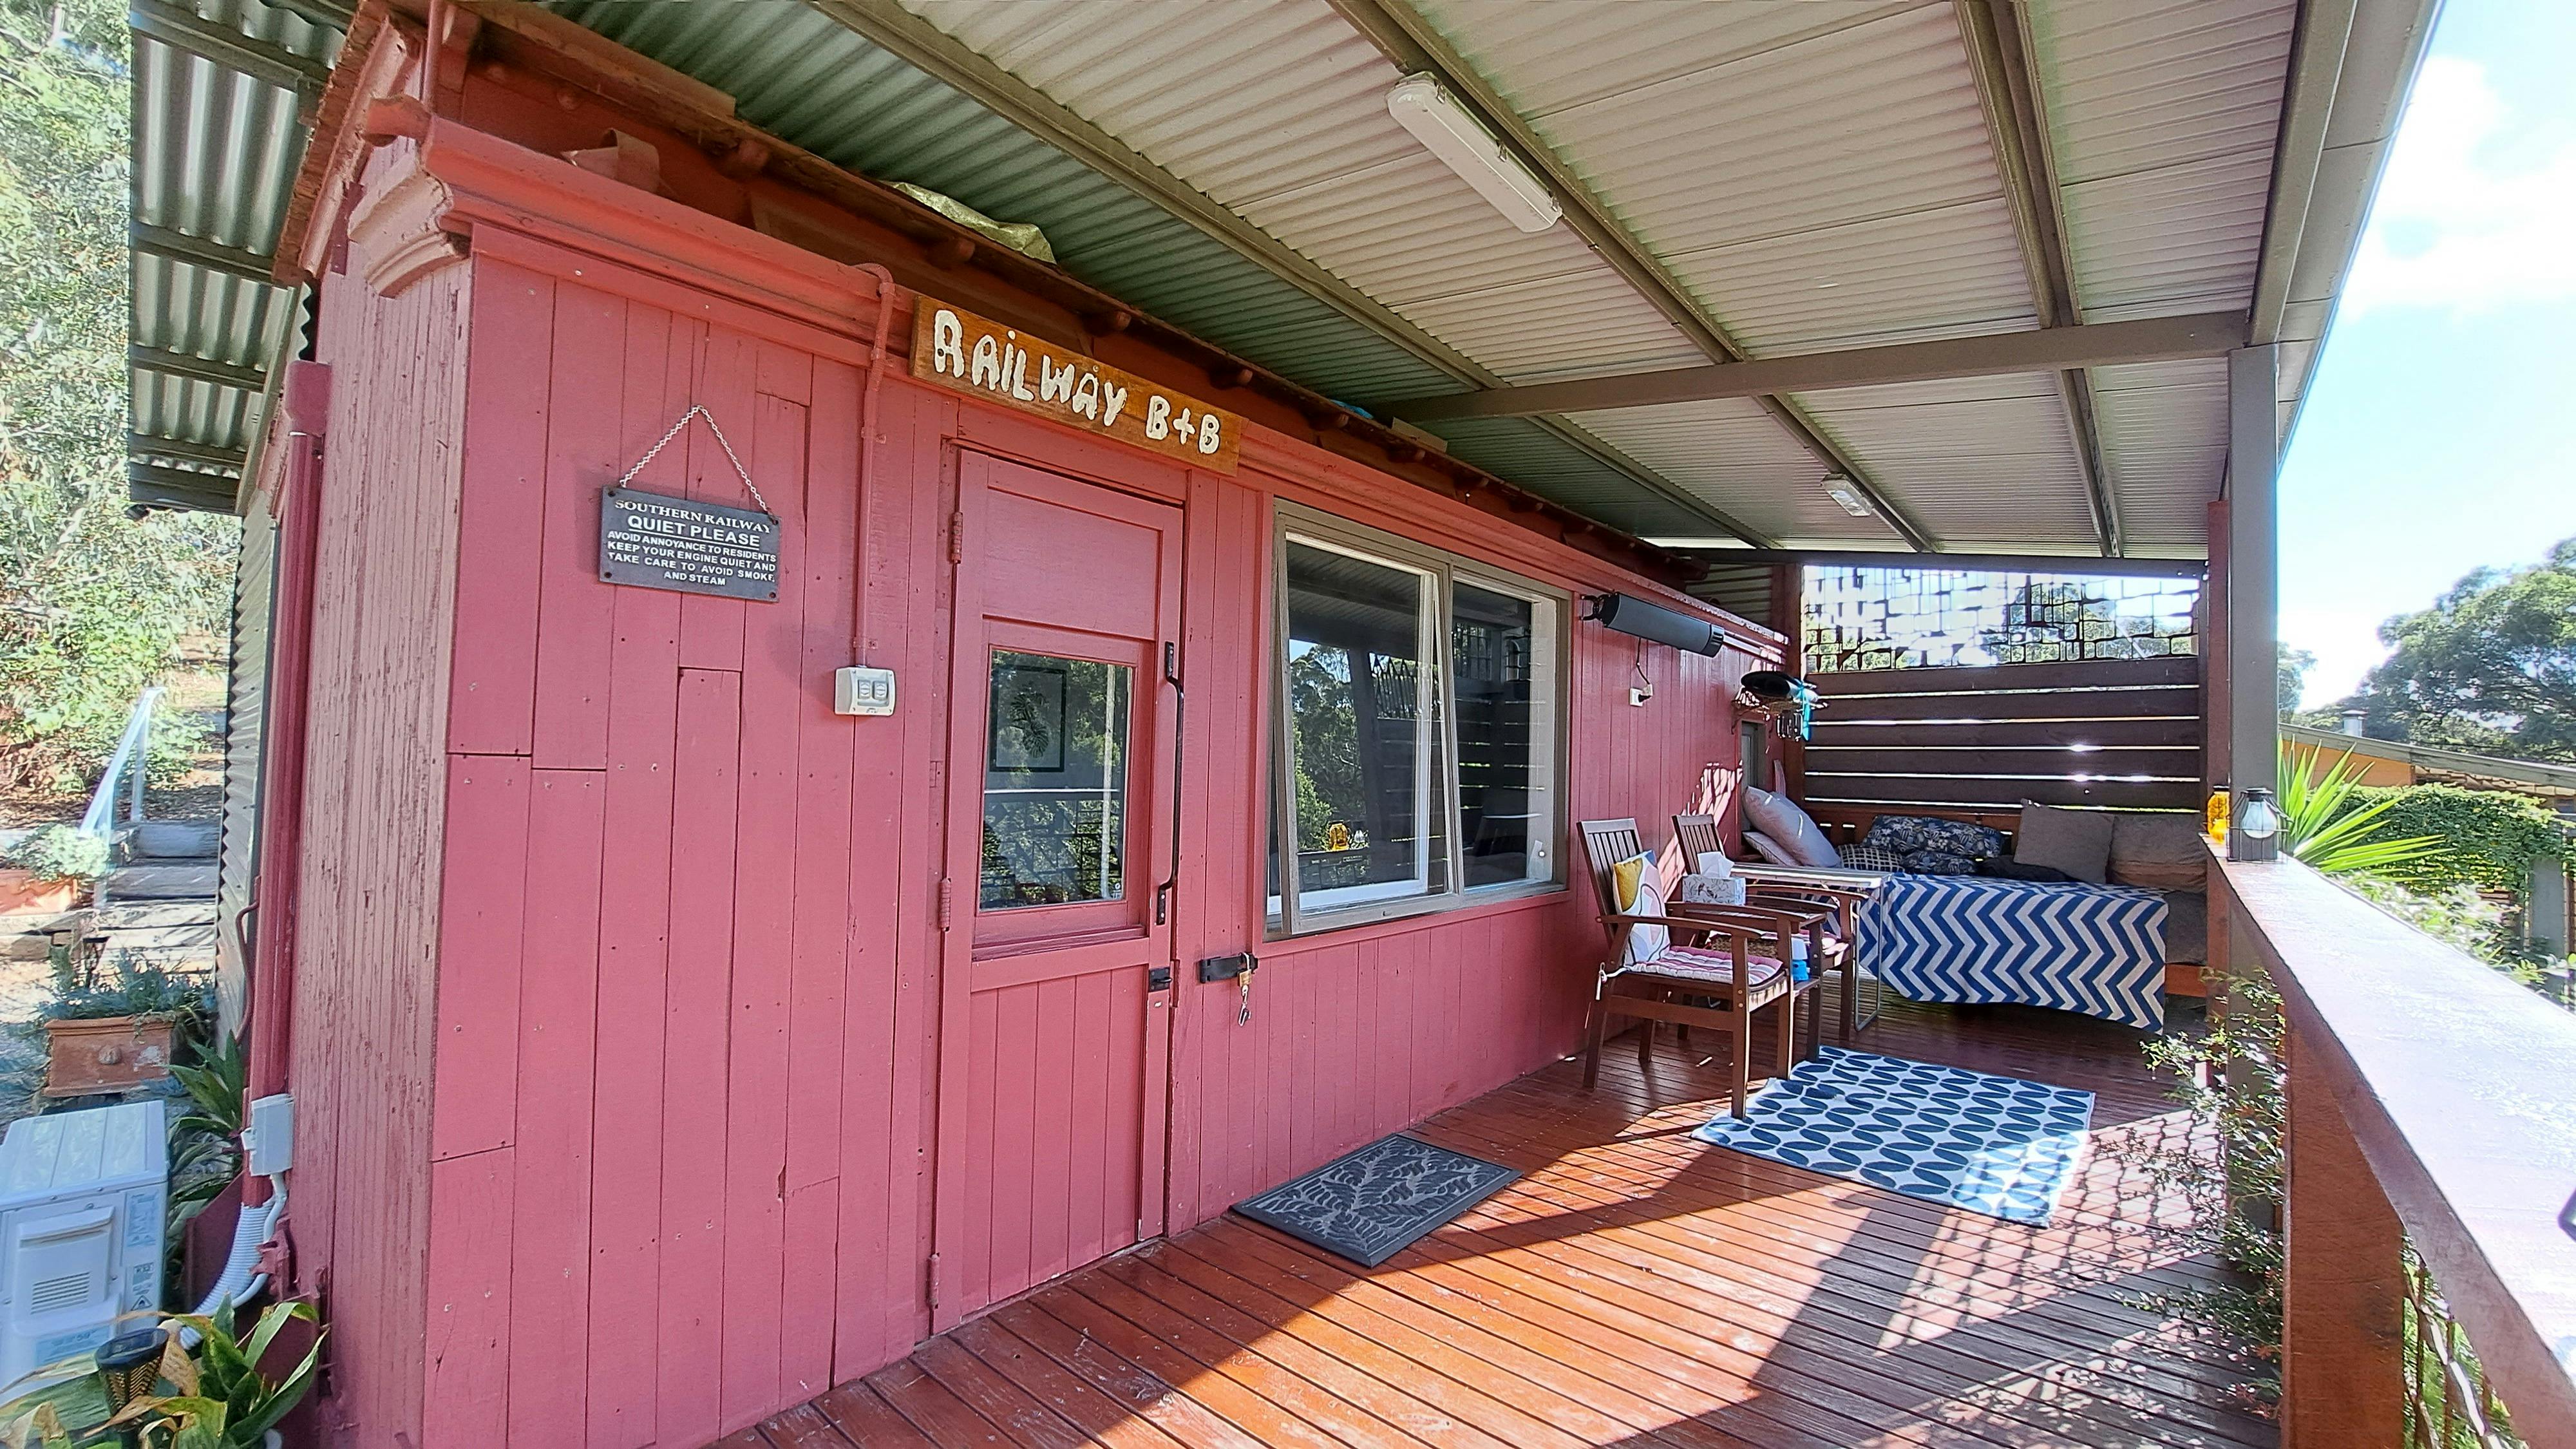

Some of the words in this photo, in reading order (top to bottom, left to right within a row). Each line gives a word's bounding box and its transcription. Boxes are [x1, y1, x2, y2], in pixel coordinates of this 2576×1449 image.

[1146, 395, 1220, 454] B+B
[615, 499, 702, 522] SOUTHERN
[705, 514, 770, 533] RAILWAY
[628, 515, 686, 535] QUIET
[690, 525, 760, 547] PLEASE
[607, 530, 641, 542] AVOID
[642, 535, 706, 552] ANNOYANCE
[708, 545, 721, 554] TO
[723, 547, 776, 562] RESIDENTS
[607, 541, 640, 553] KEEP
[642, 545, 675, 558] YOUR
[677, 551, 718, 564] ENGINE
[720, 557, 752, 569] QUIET
[753, 562, 775, 572] AND
[608, 552, 639, 564] TAKE
[644, 557, 677, 569] CARE
[681, 562, 696, 571] TO
[701, 565, 734, 576] AVOID
[664, 571, 687, 581] AND
[688, 574, 726, 585] STEAM
